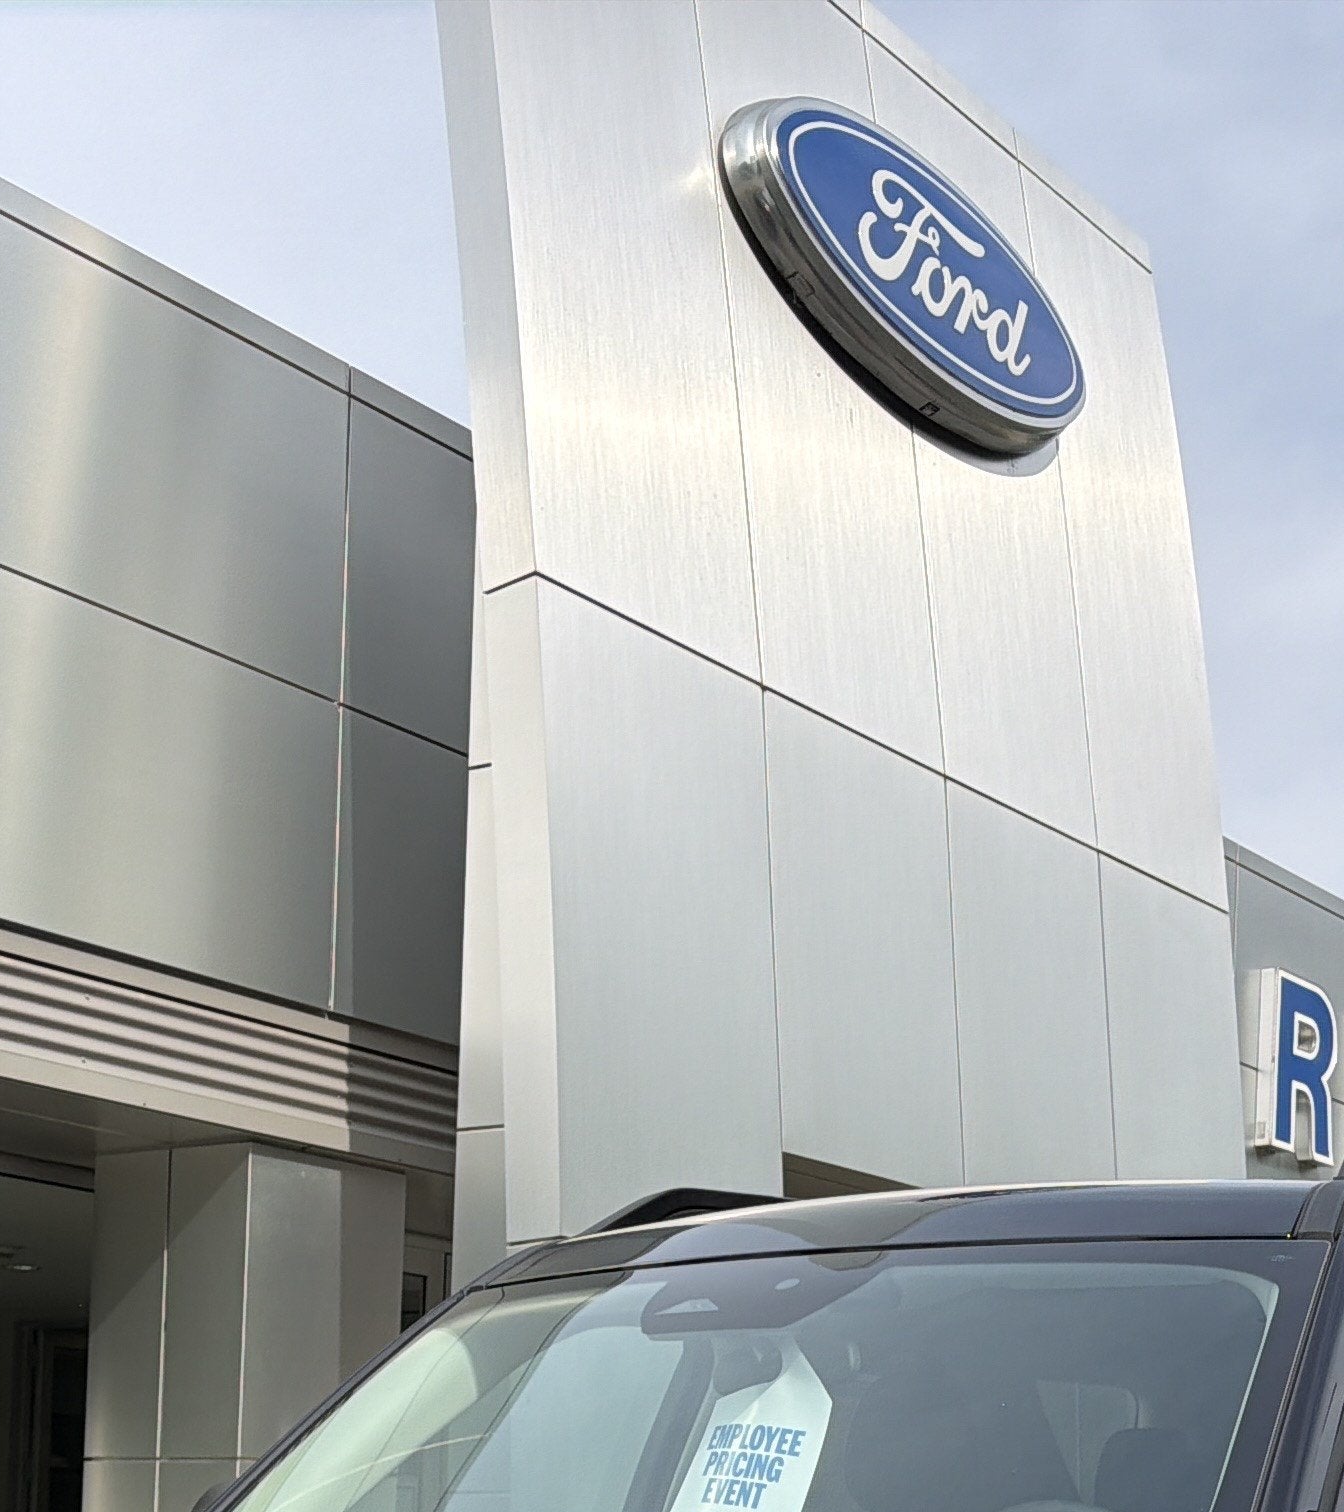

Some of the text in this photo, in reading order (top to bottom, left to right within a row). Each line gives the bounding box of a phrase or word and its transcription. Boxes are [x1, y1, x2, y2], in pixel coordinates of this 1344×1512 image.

[858, 169, 1032, 376] Ford
[706, 1423, 807, 1457] EMPLOYEE
[702, 1450, 785, 1483] PRICING
[701, 1477, 768, 1509] EVENT
